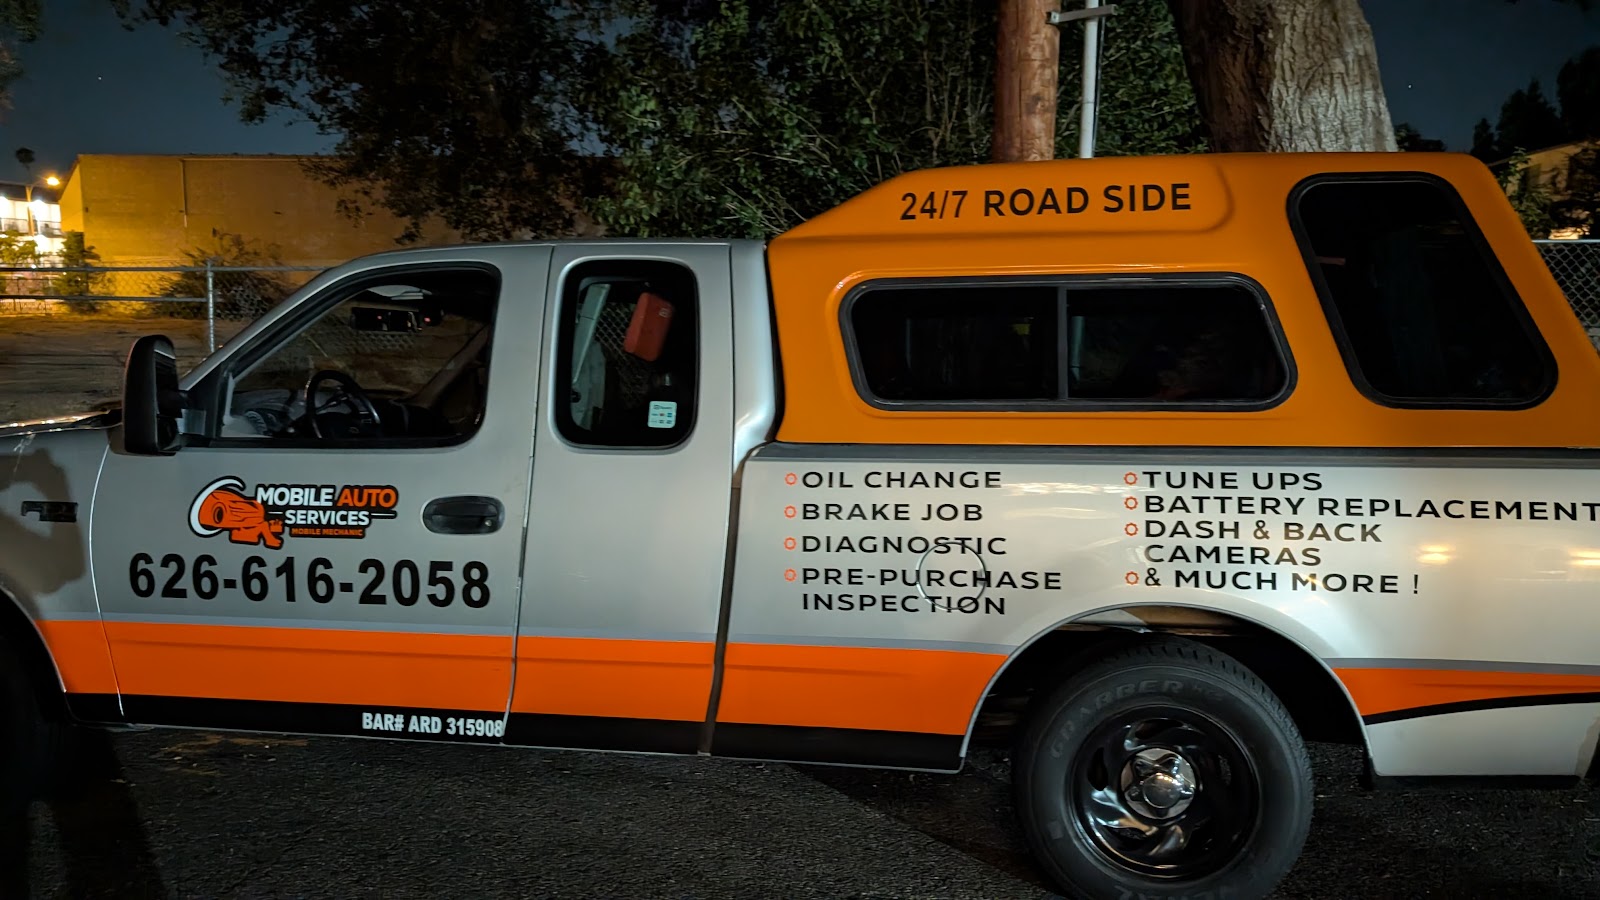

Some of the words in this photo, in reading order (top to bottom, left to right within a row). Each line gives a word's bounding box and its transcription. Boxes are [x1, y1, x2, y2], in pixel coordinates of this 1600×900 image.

[899, 190, 968, 220] 24/7
[983, 188, 1089, 217] ROAD
[1103, 183, 1191, 213] SIDE
[802, 471, 853, 488] OIL
[864, 471, 1001, 489] CHANGE
[1142, 471, 1239, 489] TUNE
[1252, 472, 1323, 490] UPS
[256, 487, 334, 506] MOBILE
[337, 488, 397, 508] AUTO
[1144, 495, 1305, 515] BATTERY
[1317, 498, 1600, 521] REPLACEMENT
[284, 510, 370, 526] SERVICES
[802, 503, 910, 521] BRAKE
[920, 504, 983, 521] JOB
[291, 528, 321, 536] MOBILE
[322, 528, 363, 537] MECHANIC
[1145, 520, 1240, 540] DASH
[1253, 520, 1270, 540] &
[1283, 522, 1382, 543] BACK
[802, 535, 1007, 556] DIAGNOSTIC
[1144, 544, 1321, 567] CAMERAS
[129, 552, 491, 609] 626-616-2058
[802, 568, 1062, 590] PRE-PURCHASE
[1144, 568, 1162, 587] &
[1174, 570, 1277, 591] MUCH
[1291, 572, 1399, 594] MORE
[802, 593, 1005, 615] INSPECTION
[361, 711, 405, 732] BAR#
[408, 715, 442, 734] ARD
[446, 717, 504, 737] 315908
